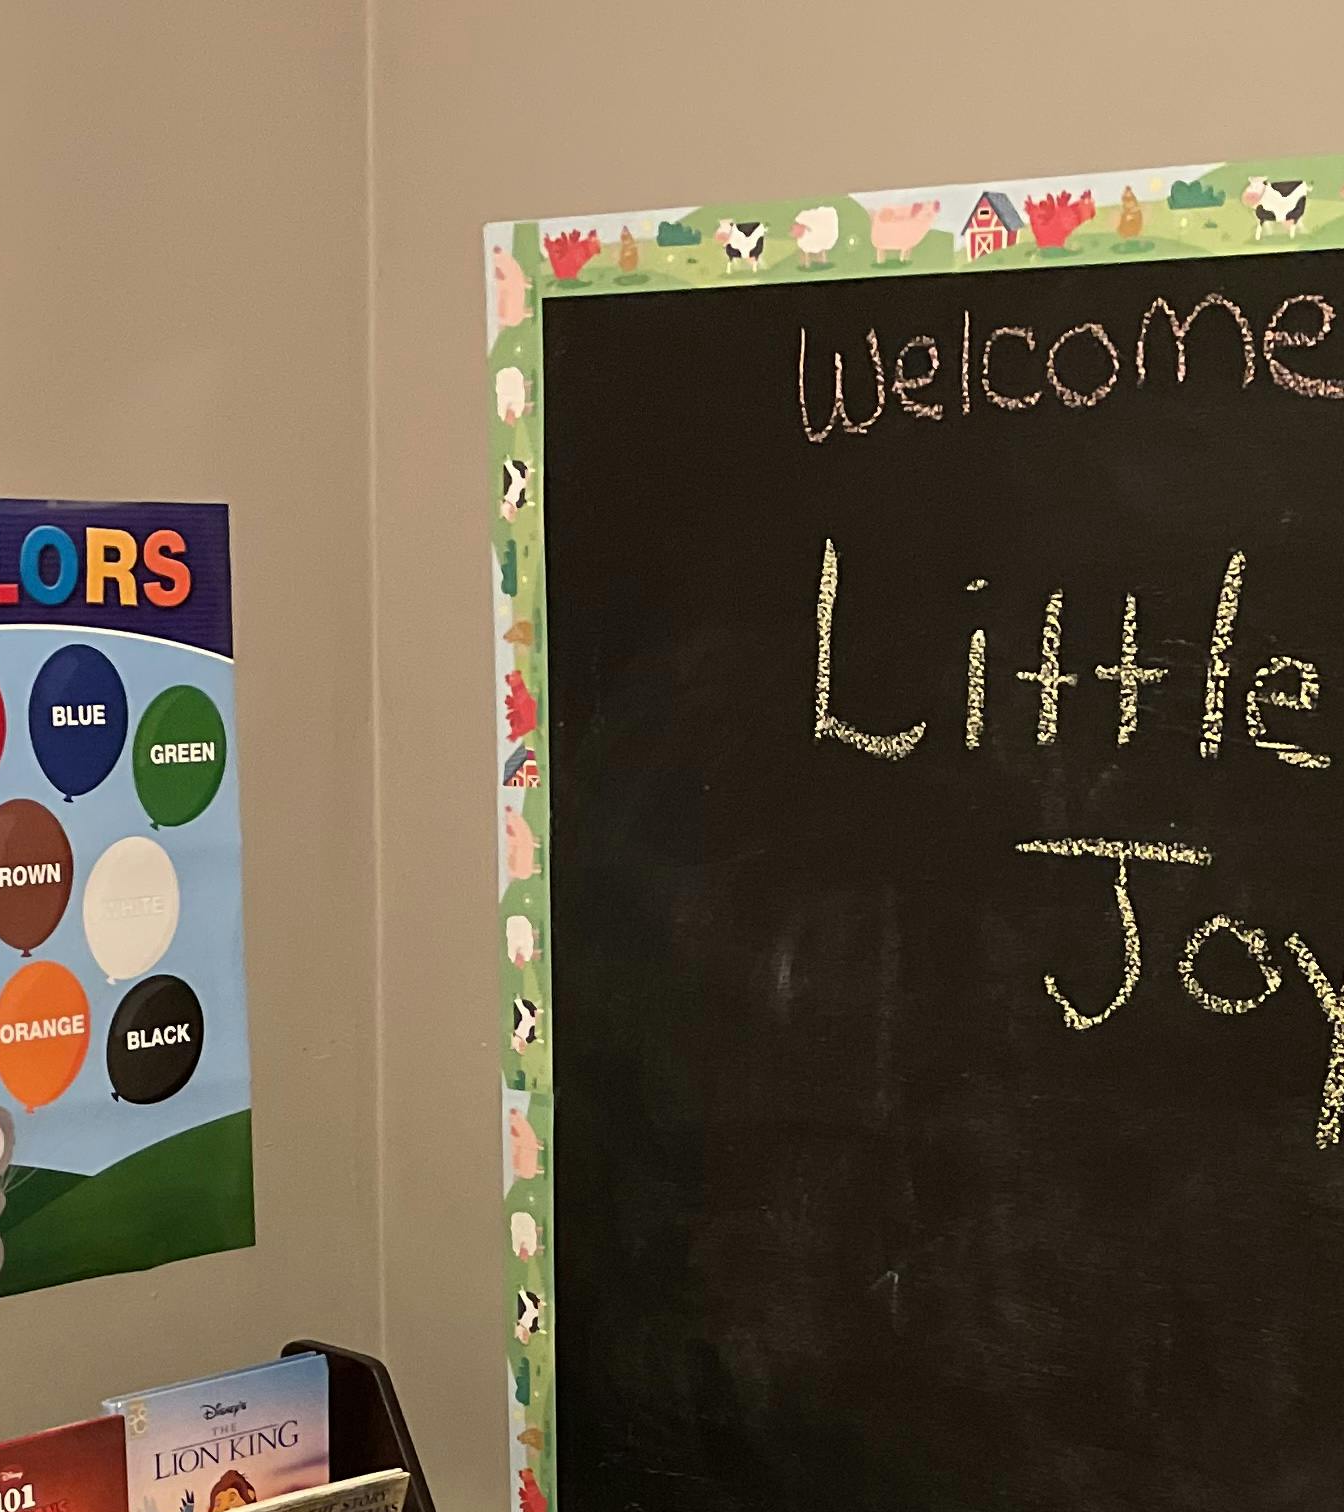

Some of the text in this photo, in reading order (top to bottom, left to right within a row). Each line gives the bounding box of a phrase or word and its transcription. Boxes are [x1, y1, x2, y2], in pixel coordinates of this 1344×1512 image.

[813, 538, 1332, 769] Little
[50, 704, 107, 727] BLUE
[149, 742, 216, 765] GREEN
[0, 1014, 85, 1044] ORANGE
[126, 1023, 191, 1050] BLACK
[200, 1401, 247, 1420] Disney's
[212, 1423, 237, 1436] THE
[153, 1419, 300, 1481] LION KING
